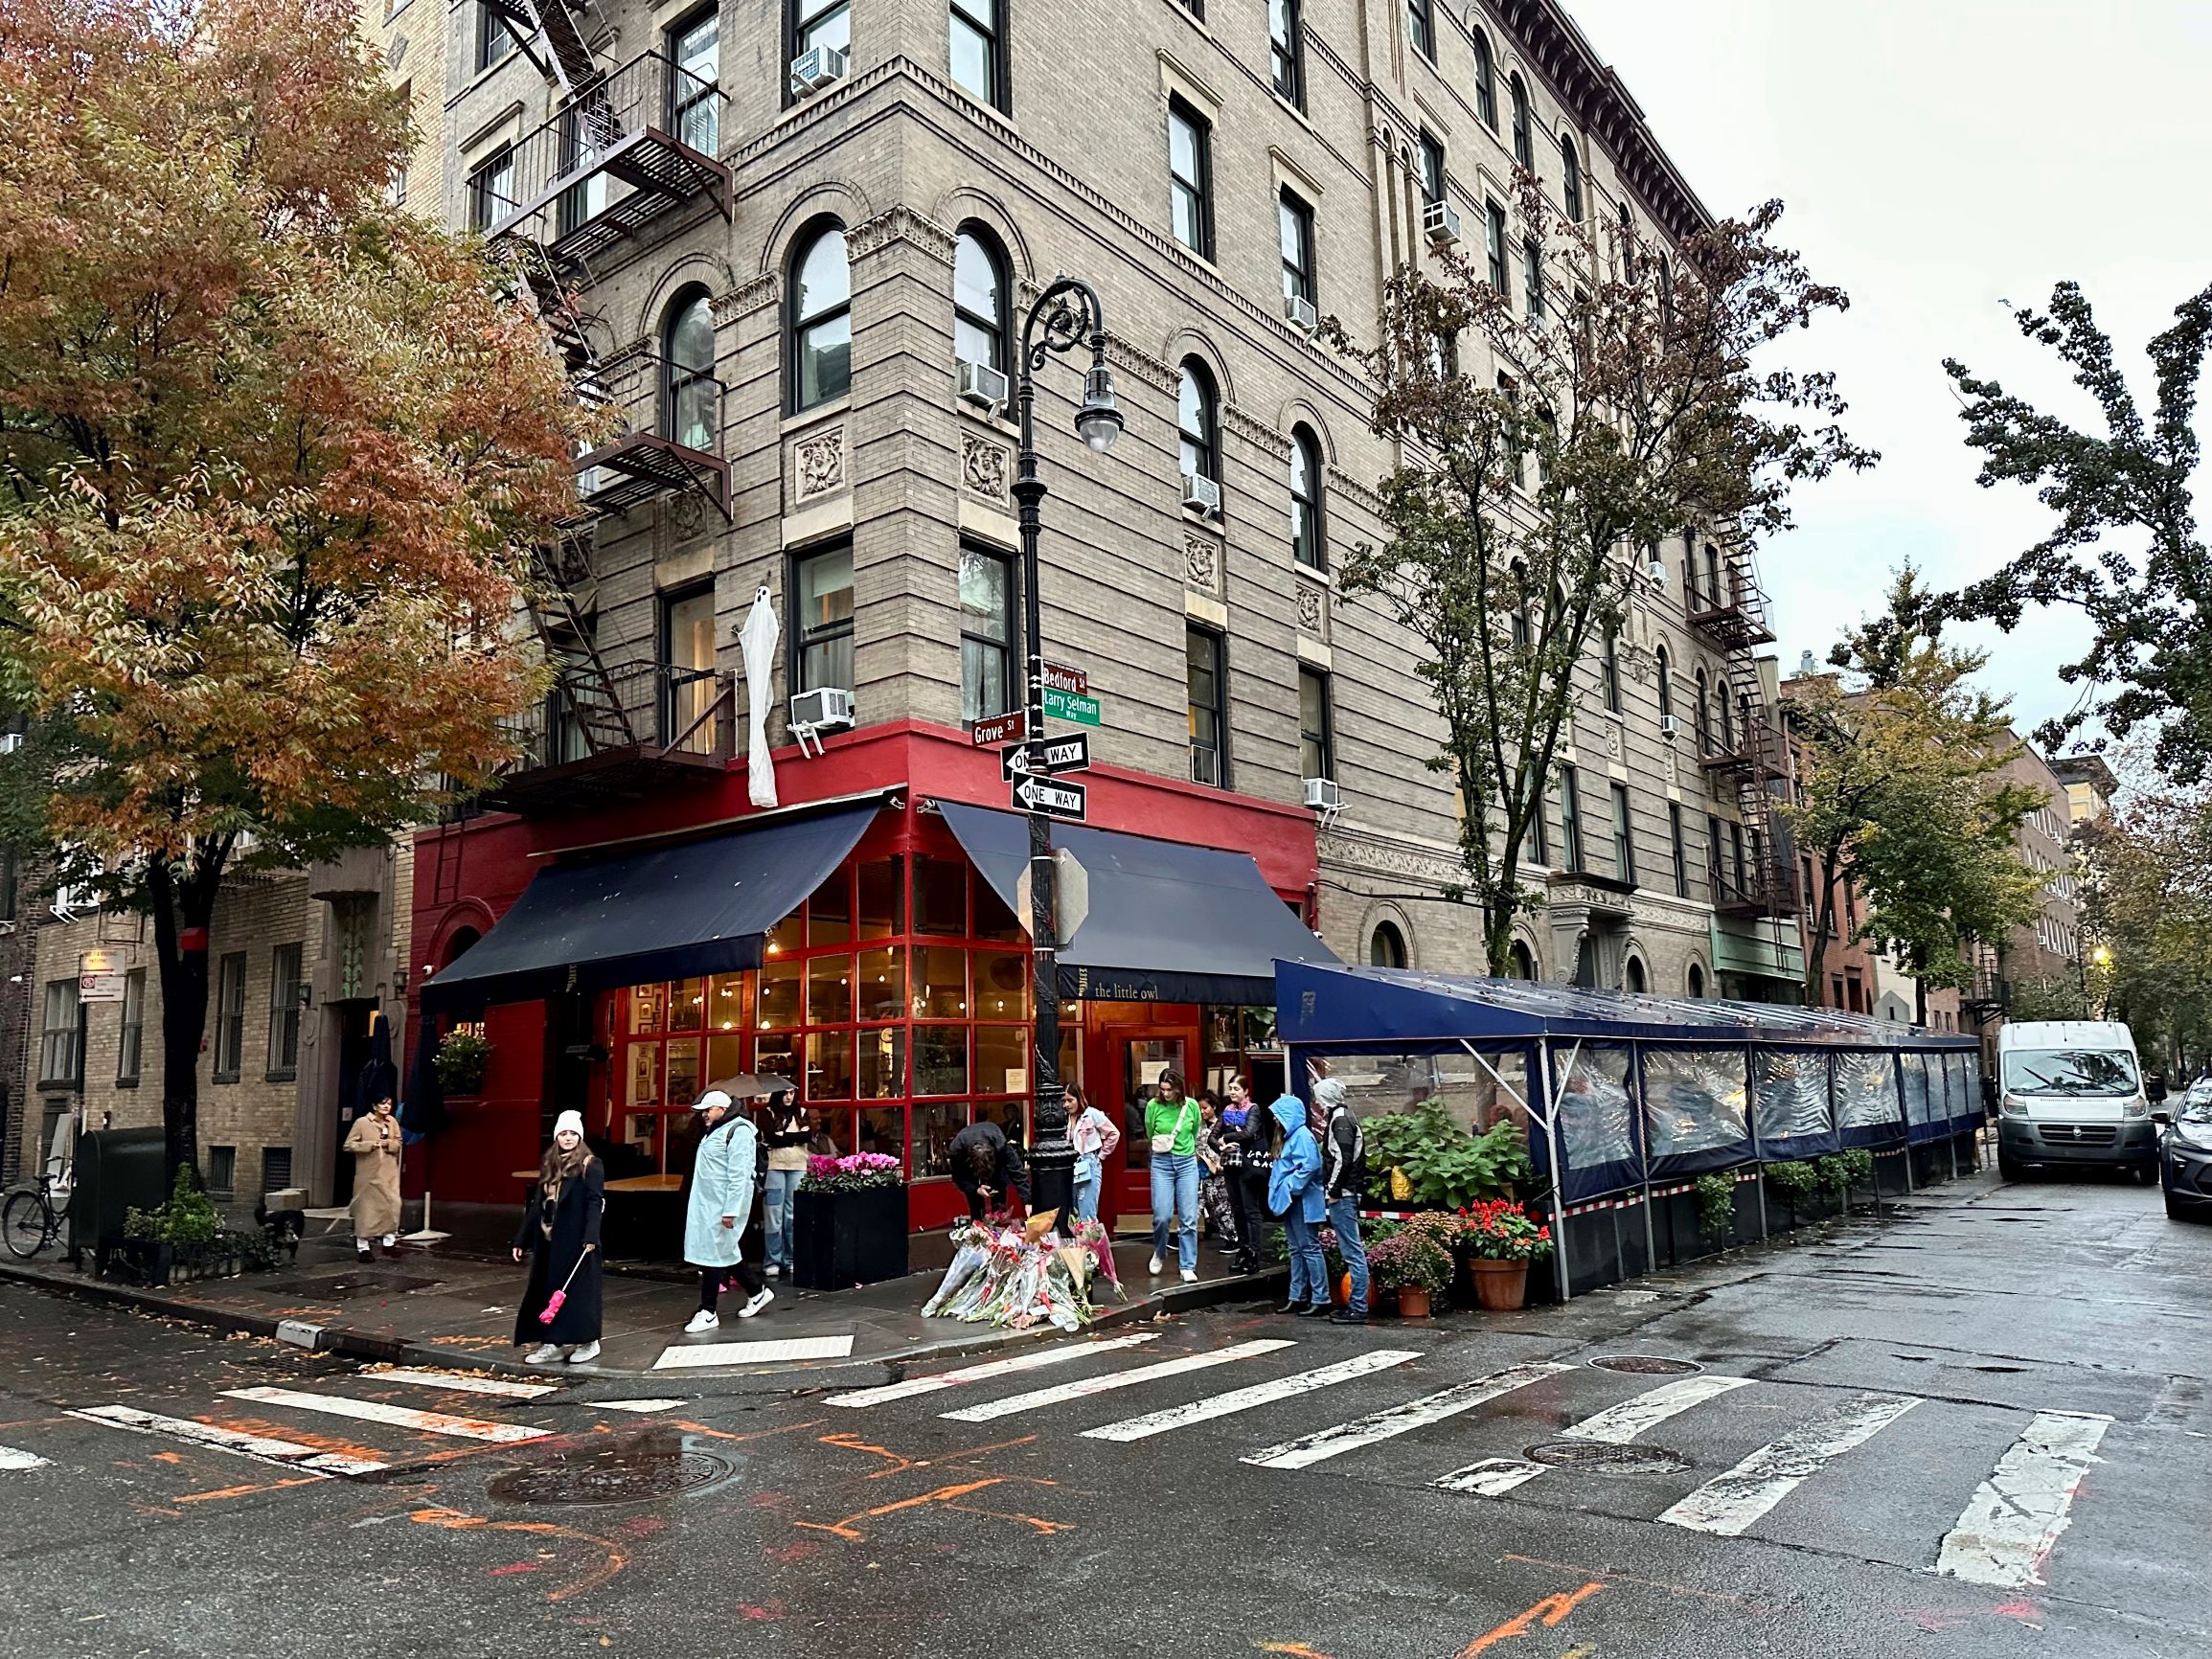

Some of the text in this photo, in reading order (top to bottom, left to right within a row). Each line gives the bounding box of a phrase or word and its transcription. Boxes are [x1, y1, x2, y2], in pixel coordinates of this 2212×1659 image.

[1044, 667, 1076, 692] Bedford
[1080, 677, 1085, 689] St
[1044, 691, 1097, 716] Larry Selman
[1066, 710, 1077, 720] Way
[975, 719, 1015, 744] Grove St
[1015, 744, 1077, 768] ON WAY
[1024, 785, 1077, 808] ONE WAY
[1095, 983, 1158, 1000] the little owl
